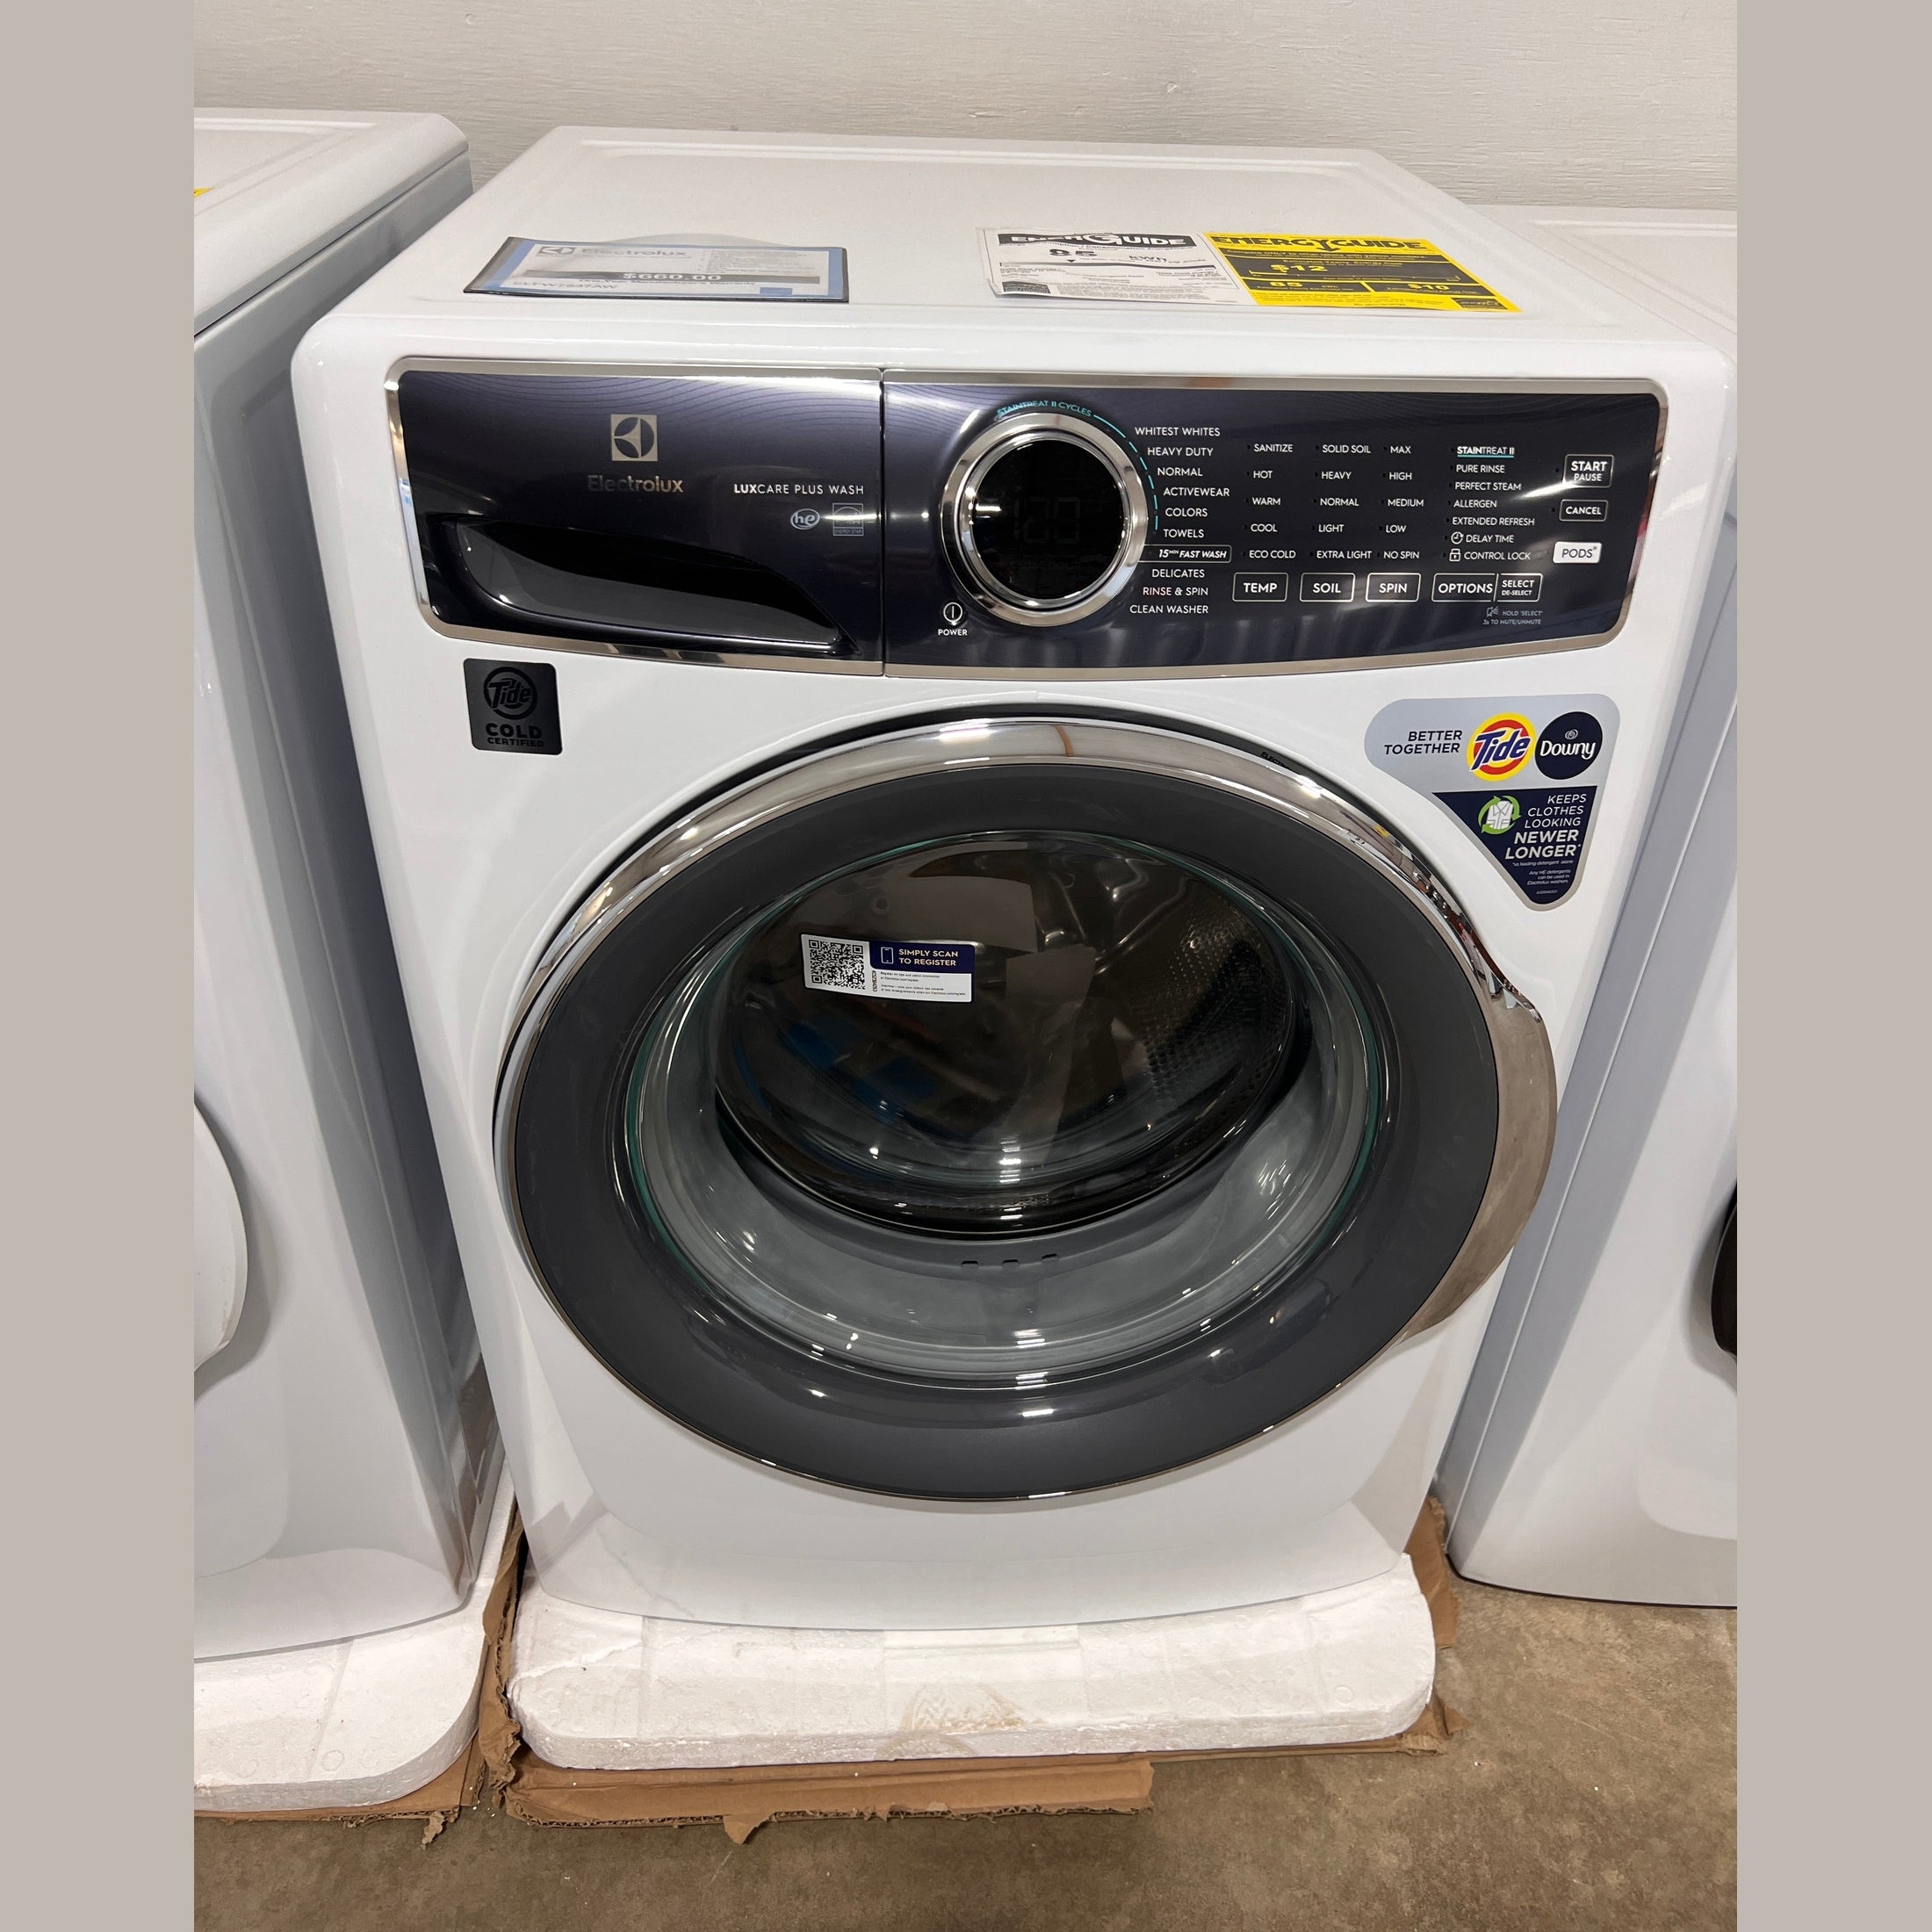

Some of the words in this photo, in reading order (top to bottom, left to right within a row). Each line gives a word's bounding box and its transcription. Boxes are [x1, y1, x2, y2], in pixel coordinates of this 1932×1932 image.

[1211, 236, 1427, 251] ENERGYGUIDE
[623, 272, 722, 281] $660.00
[997, 400, 1049, 417] STAINTREAT
[1058, 401, 1092, 417] CYCLES
[1135, 427, 1179, 436] WHITEST
[1182, 427, 1221, 436] WHITES
[1147, 447, 1182, 457] HEAVY
[1186, 447, 1214, 457] DUTY
[1254, 443, 1294, 453] SANITIZE
[1323, 444, 1349, 453] SOLID
[1351, 445, 1371, 454] SOIL
[1390, 445, 1411, 454] MAX
[1457, 446, 1508, 455] STAINTREAT
[1456, 465, 1479, 473] PURE
[1571, 461, 1608, 472] START
[1157, 468, 1203, 477] NORMAL
[588, 475, 683, 493] Electrolux
[733, 484, 789, 494] LUXCARE
[795, 484, 824, 494] PLUS
[829, 485, 864, 494] WASH
[1163, 487, 1230, 497] ACTIVEWEAR
[1252, 497, 1281, 506] WARM
[1320, 498, 1359, 507] NORMAL
[1165, 508, 1208, 517] COLORS
[1452, 517, 1497, 526] EXTENDED
[1251, 523, 1278, 532] COOL
[1318, 524, 1344, 533] LIGHT
[1163, 529, 1204, 538] TOWELS
[1383, 551, 1399, 559] NO
[1400, 551, 1420, 559] SPIN
[1464, 551, 1505, 560] CONTROL
[1151, 569, 1205, 578] DELICATES
[1244, 583, 1278, 594] TEMP
[1313, 583, 1341, 594] SOIL
[1379, 583, 1408, 594] SPIN
[1438, 583, 1493, 594] OPTIONS
[1502, 580, 1534, 588] SELECT
[1143, 587, 1172, 596] RINSE
[1174, 587, 1183, 596] &
[1186, 587, 1208, 596] SPIN
[1129, 605, 1164, 615] CLEAN
[1166, 605, 1209, 615] WASHER
[488, 678, 532, 710] Tide
[485, 723, 543, 739] COLD
[1408, 730, 1462, 742] BETTER
[487, 737, 544, 747] CERTIFIED
[1384, 743, 1460, 755] TOGETHER
[1470, 728, 1532, 772] Tide
[1539, 740, 1596, 760] Downy
[1547, 794, 1587, 804] KEEPS
[1527, 805, 1584, 817] CLOTHES
[1524, 818, 1581, 829] LOOKING
[1514, 829, 1579, 845] NEWER
[898, 948, 931, 957] SIMPLY
